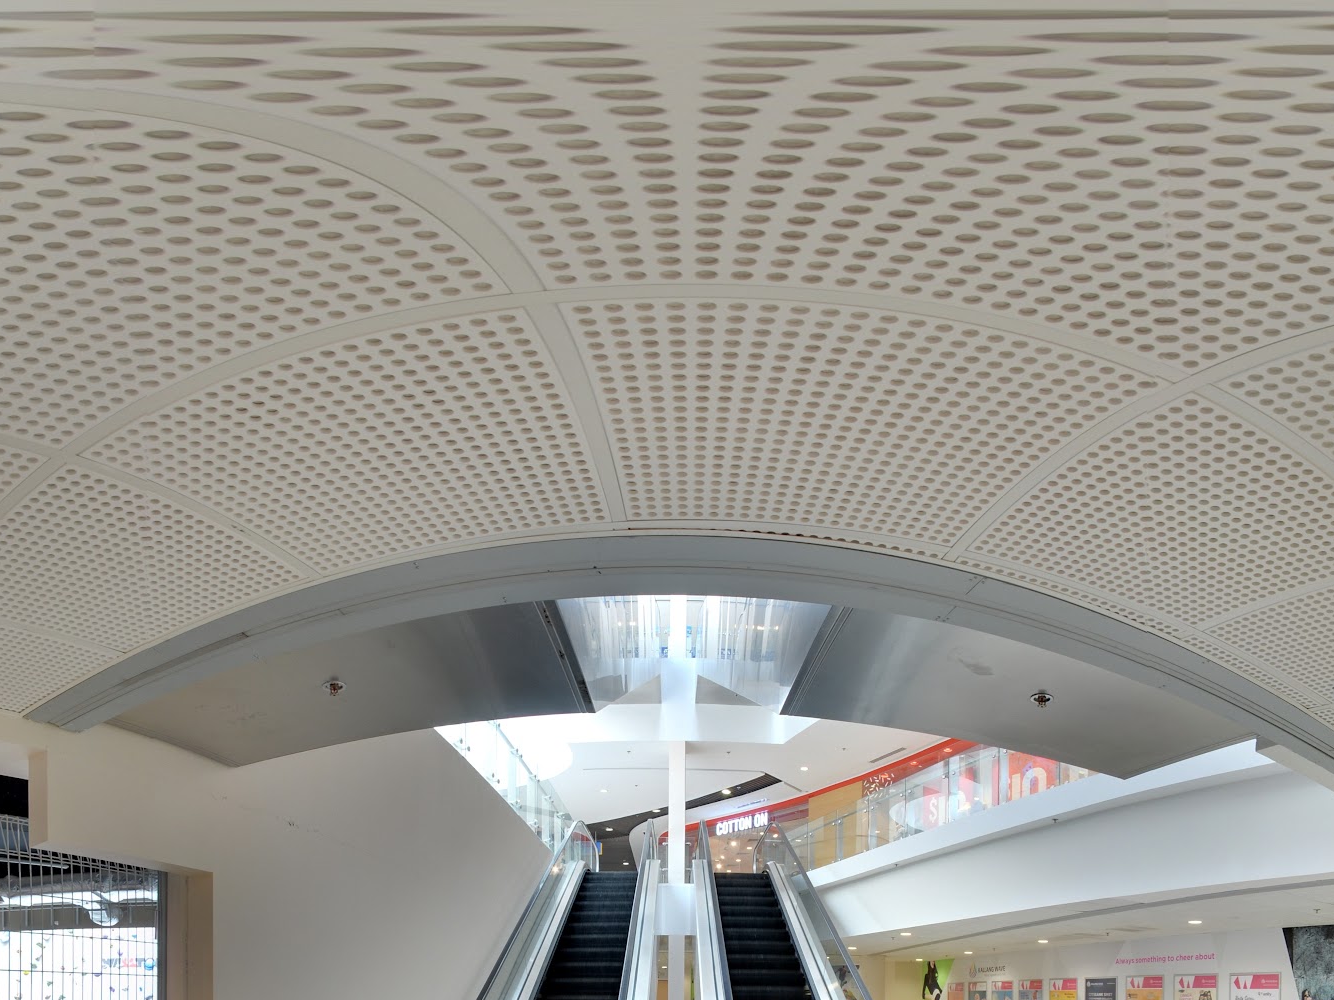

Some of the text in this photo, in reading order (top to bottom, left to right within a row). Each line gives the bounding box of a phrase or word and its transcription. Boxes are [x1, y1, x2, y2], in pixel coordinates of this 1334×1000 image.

[715, 811, 769, 836] COTTON ON
[1135, 955, 1167, 964] something
[1194, 952, 1215, 960] about
